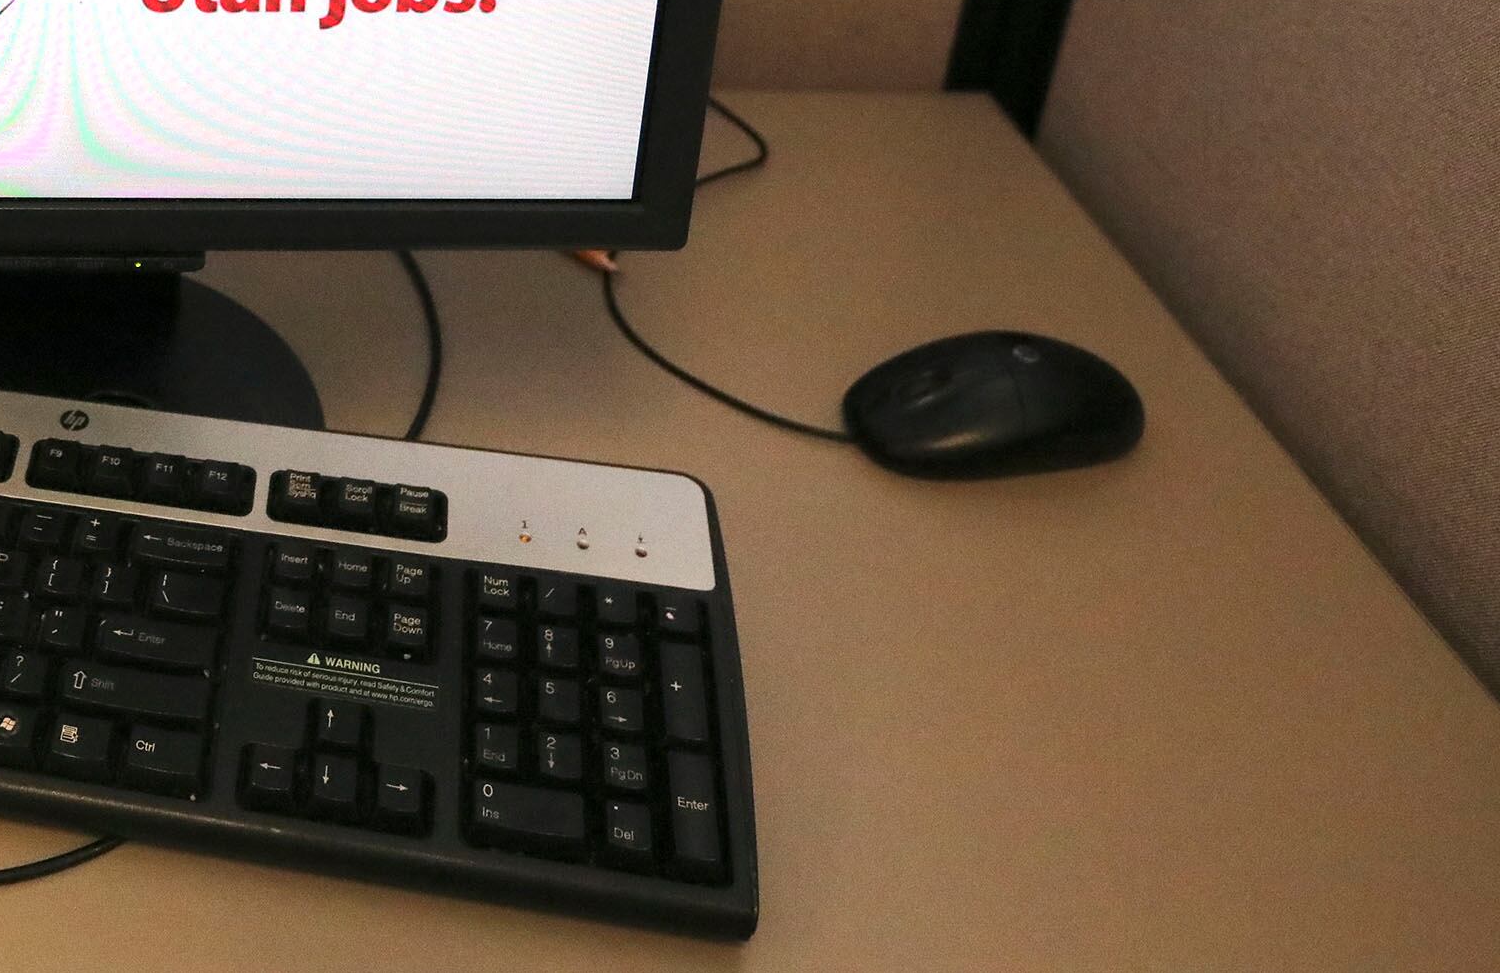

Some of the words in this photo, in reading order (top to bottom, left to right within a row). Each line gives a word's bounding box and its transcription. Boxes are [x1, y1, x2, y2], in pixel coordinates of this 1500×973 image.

[60, 409, 88, 431] hp
[50, 449, 63, 459] F9
[101, 455, 121, 467] F10
[155, 463, 174, 473] F11
[208, 470, 228, 482] F12
[346, 484, 373, 495] Scroll
[400, 487, 429, 498] Pause
[345, 492, 369, 502] Lock
[399, 503, 428, 515] Break
[578, 527, 587, 536] A
[166, 537, 224, 553] Backspace
[281, 553, 309, 565] Insert
[338, 561, 368, 573] Home
[396, 564, 423, 577] Page
[396, 573, 411, 584] Up
[484, 575, 509, 587] Num
[484, 585, 510, 597] Lock
[275, 600, 306, 614] Delete
[335, 610, 356, 622] End
[393, 613, 421, 626] Page
[393, 623, 423, 635] Down
[484, 620, 493, 631] 7
[138, 632, 167, 645] Enter
[544, 629, 554, 642] 8
[483, 640, 513, 652] Home
[605, 637, 615, 649] 9
[325, 656, 381, 674] WARNING
[605, 657, 636, 670] PgUp
[91, 678, 115, 691] Shift
[253, 671, 274, 682] Guide
[275, 675, 305, 687] provided
[306, 679, 320, 689] with
[321, 682, 348, 694] product
[349, 686, 363, 696] and
[256, 662, 264, 671] To
[265, 664, 289, 675] reduce
[290, 668, 302, 676] risk
[303, 669, 311, 678] of
[360, 679, 376, 688] read
[378, 682, 399, 694] Safety
[483, 673, 493, 684] 4
[545, 682, 555, 695] 5
[606, 691, 617, 704] 6
[484, 727, 491, 740] 1
[135, 740, 156, 753] Ctrl
[546, 736, 557, 749] 2
[483, 749, 506, 763] End
[610, 747, 620, 760] 3
[611, 767, 643, 781] PgDn
[676, 796, 710, 811] Enter
[482, 806, 500, 819] Ins
[614, 827, 635, 841] Del
